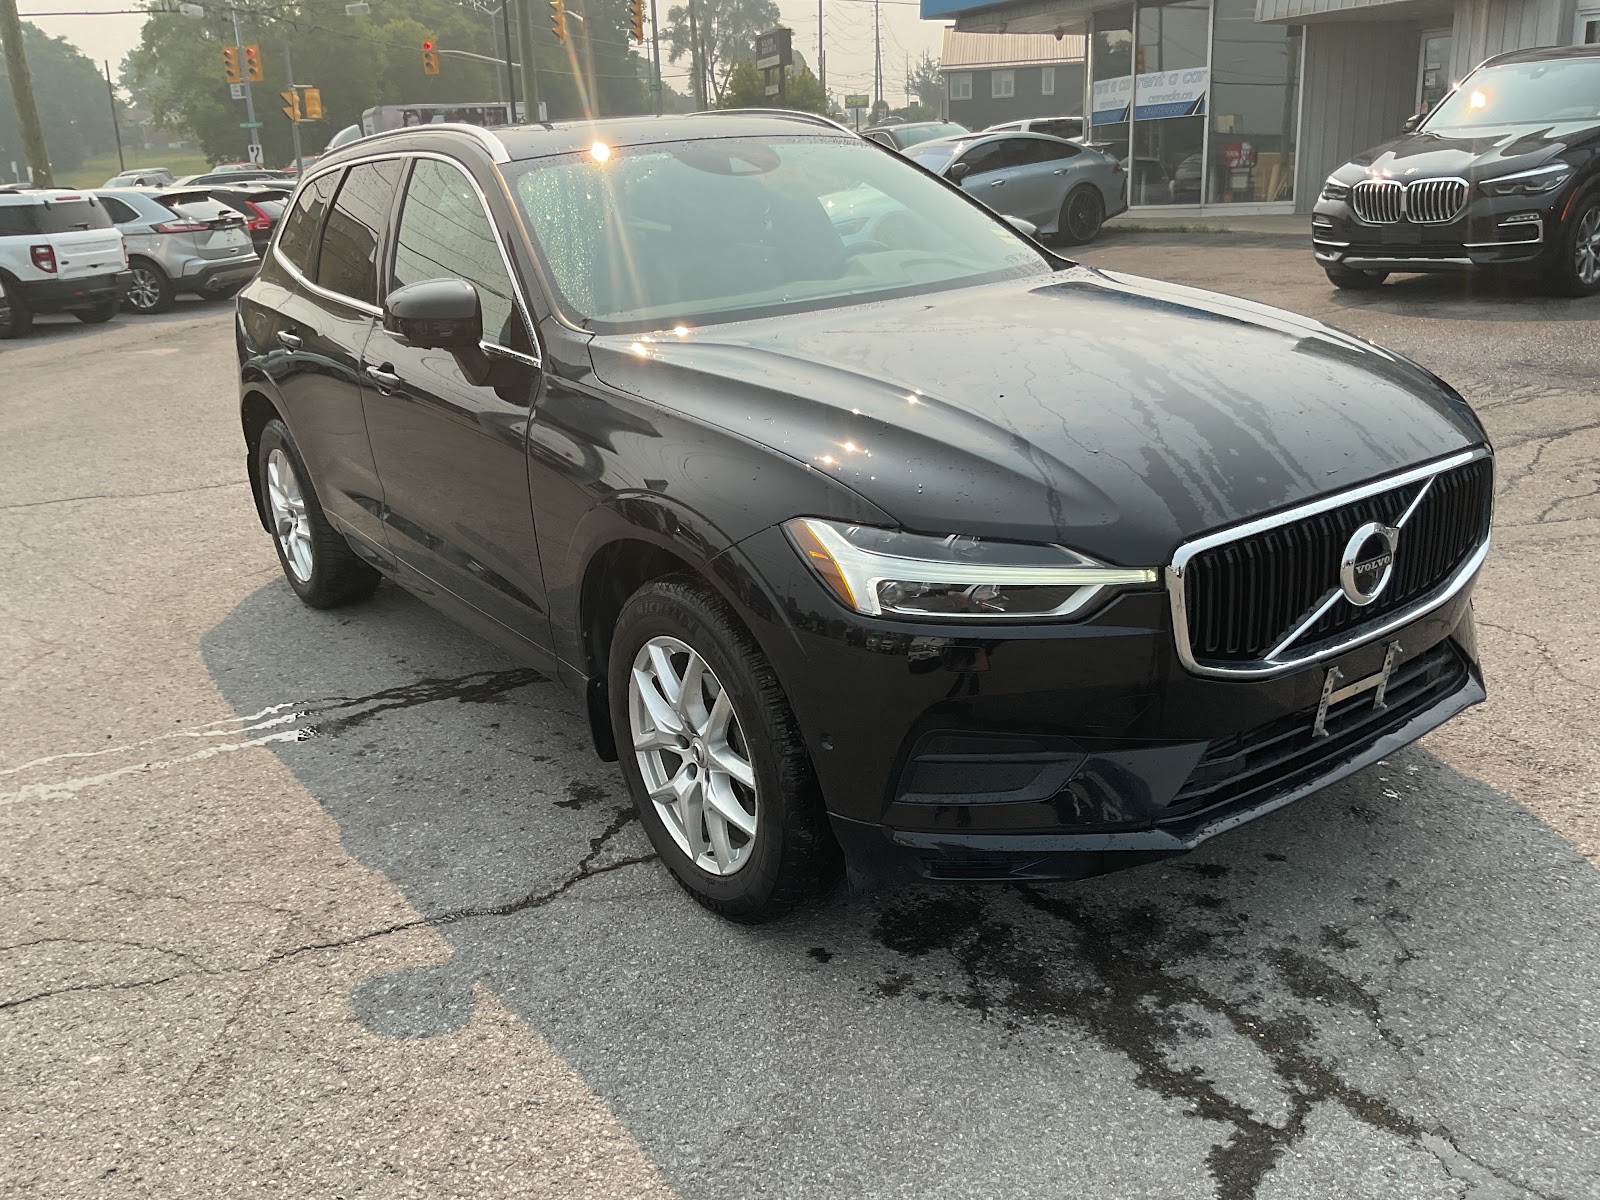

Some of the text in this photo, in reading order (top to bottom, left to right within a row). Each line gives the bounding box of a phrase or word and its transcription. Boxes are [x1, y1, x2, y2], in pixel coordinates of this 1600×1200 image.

[1138, 73, 1165, 88] rent
[1168, 73, 1179, 86] a
[1356, 556, 1389, 573] VOLVO
